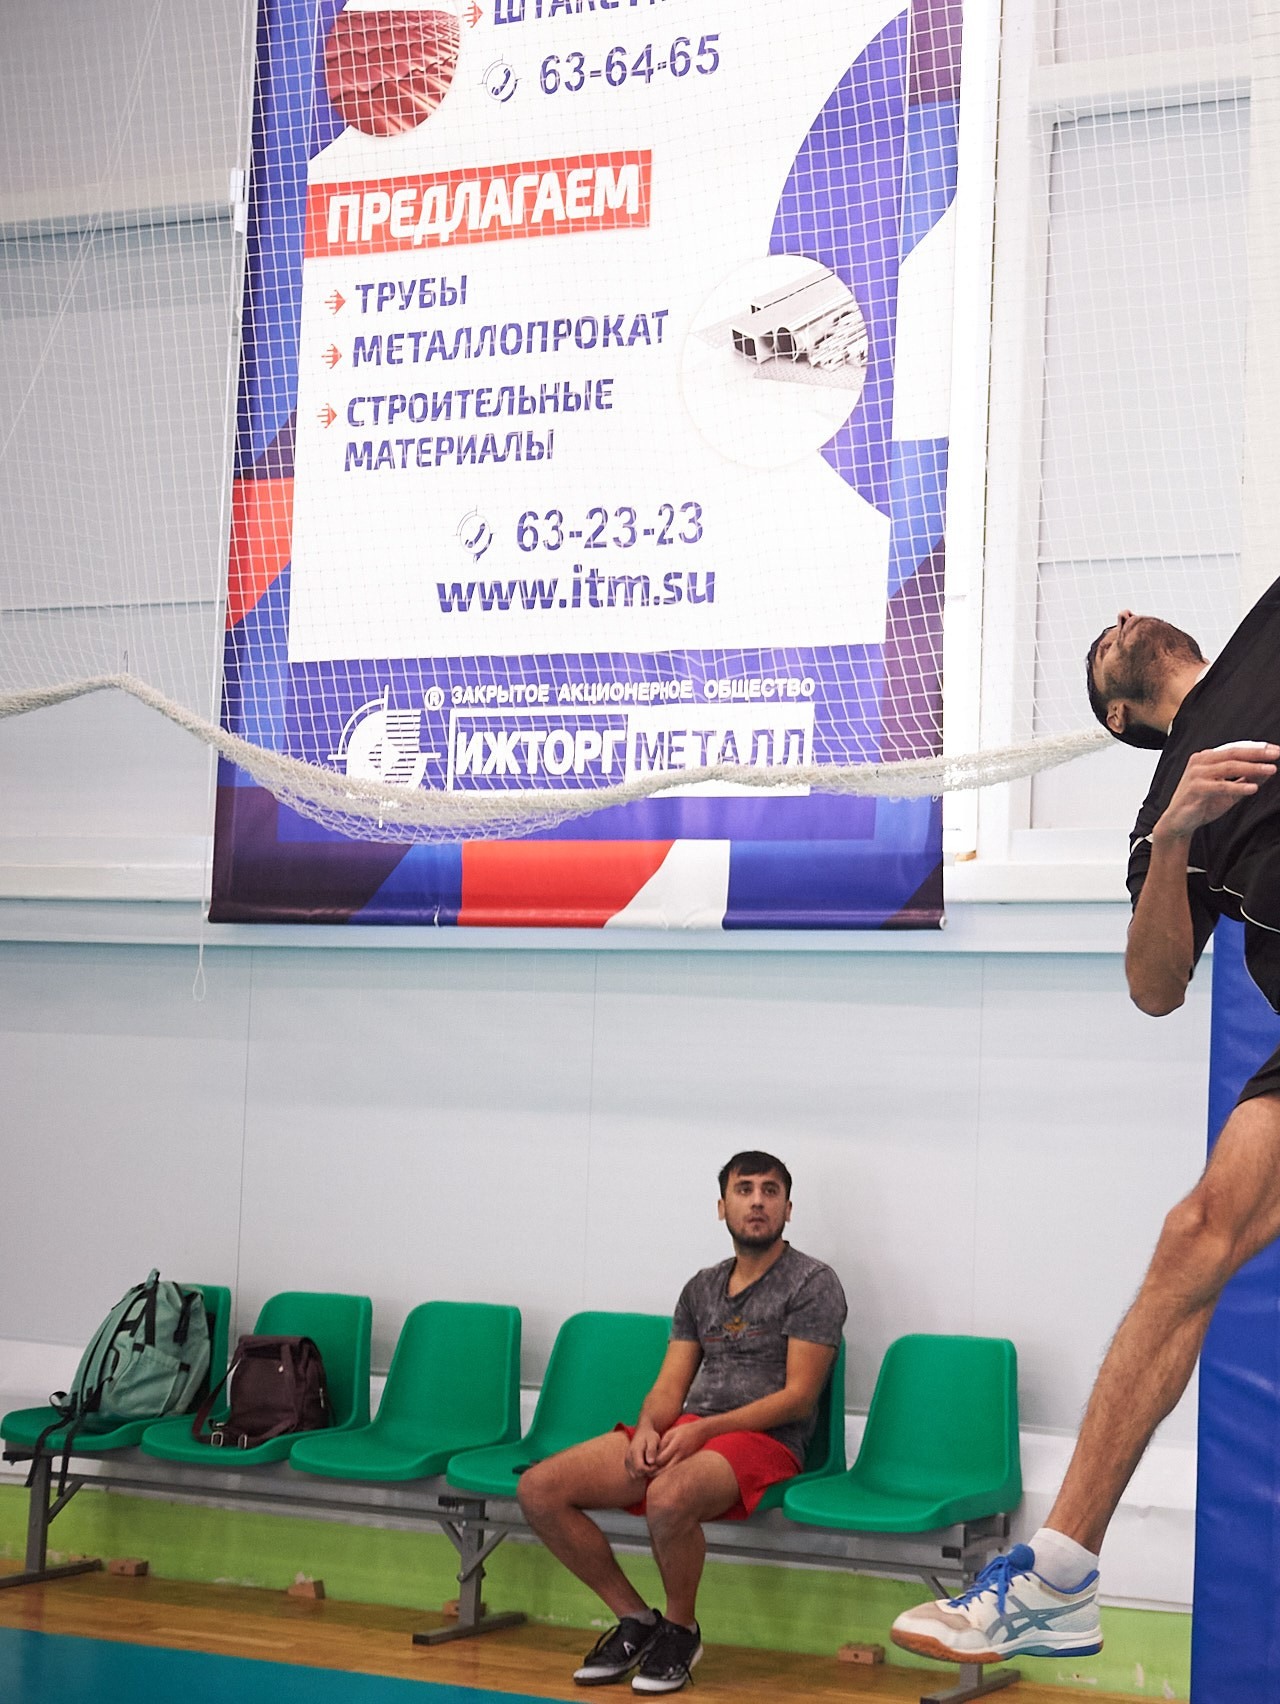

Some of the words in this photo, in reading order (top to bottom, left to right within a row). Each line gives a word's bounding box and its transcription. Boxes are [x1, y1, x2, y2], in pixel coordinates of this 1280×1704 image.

[540, 34, 721, 95] 63-64-65
[326, 163, 641, 246] ПРЕДЛАГАЕМ
[354, 275, 468, 314] ТРУБЫ
[352, 310, 670, 368] МЕТАЛЛОПРОКАТ
[346, 379, 614, 428] СТРОИТЕЛЬНЫЕ
[345, 429, 555, 472] МАТЕРИАЛЫ
[516, 502, 704, 553] 63-23-23
[437, 564, 716, 613] www.itm.su
[451, 684, 550, 705] ЗАКРЫТОЕ
[558, 680, 693, 703] АКЦИОНЕРНОЕ
[703, 677, 815, 701] ОБЩЕСТВО
